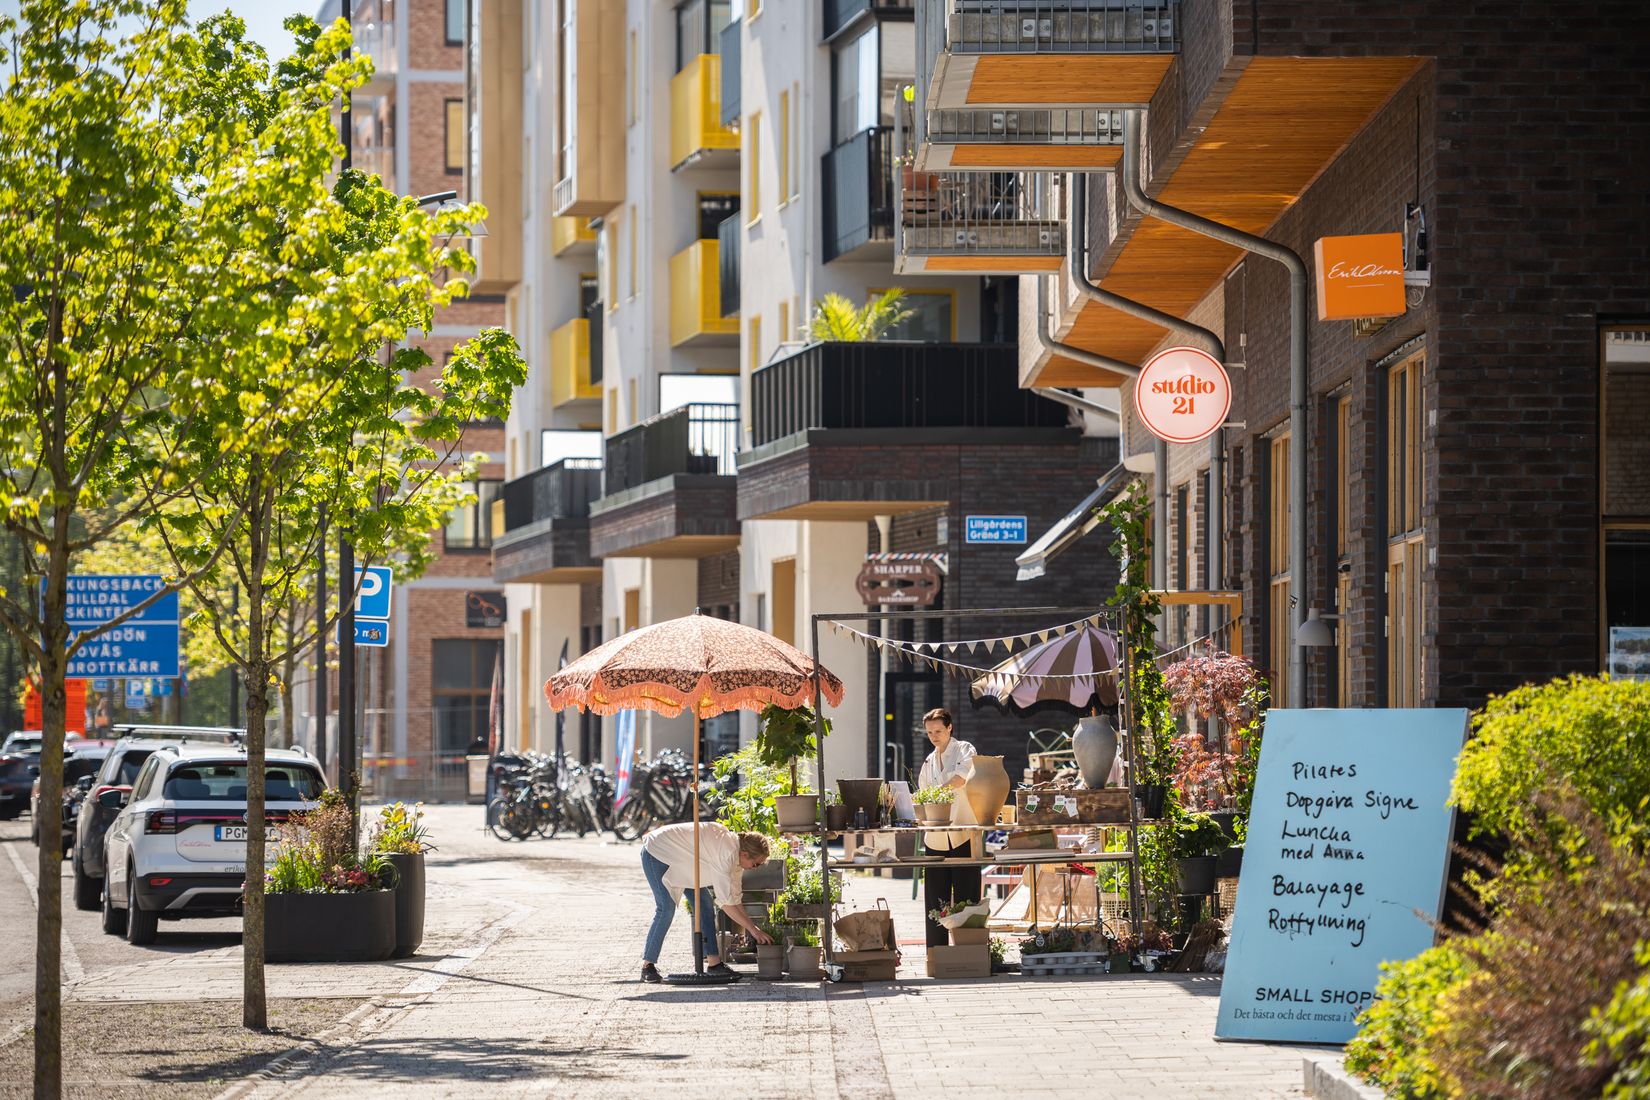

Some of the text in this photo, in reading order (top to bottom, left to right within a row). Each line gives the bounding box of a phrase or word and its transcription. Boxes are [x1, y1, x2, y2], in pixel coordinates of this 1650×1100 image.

[1152, 374, 1215, 395] studio
[1172, 397, 1195, 415] 21
[970, 519, 1023, 531] Lillgårdens
[970, 530, 1018, 540] Gränd 3-1
[874, 565, 922, 574] SHARPER
[66, 578, 162, 591] KUNGSBACK
[66, 593, 129, 605] BILLDAL
[71, 643, 122, 658] OVÅS
[66, 658, 160, 673] BROTTKÄRR
[1292, 761, 1357, 780] Pilates
[1365, 790, 1419, 819] Signe
[1281, 820, 1351, 841] Luncha
[1281, 843, 1365, 860] med Anna
[1272, 874, 1365, 909] Balayage
[1268, 908, 1366, 948] Rotfyllning
[1255, 987, 1313, 1003] SMALL
[1234, 1008, 1250, 1019] Det
[1252, 1009, 1275, 1019] bästa
[1277, 1009, 1294, 1020] och
[1296, 1009, 1311, 1021] det
[1314, 1012, 1341, 1022] mesta
